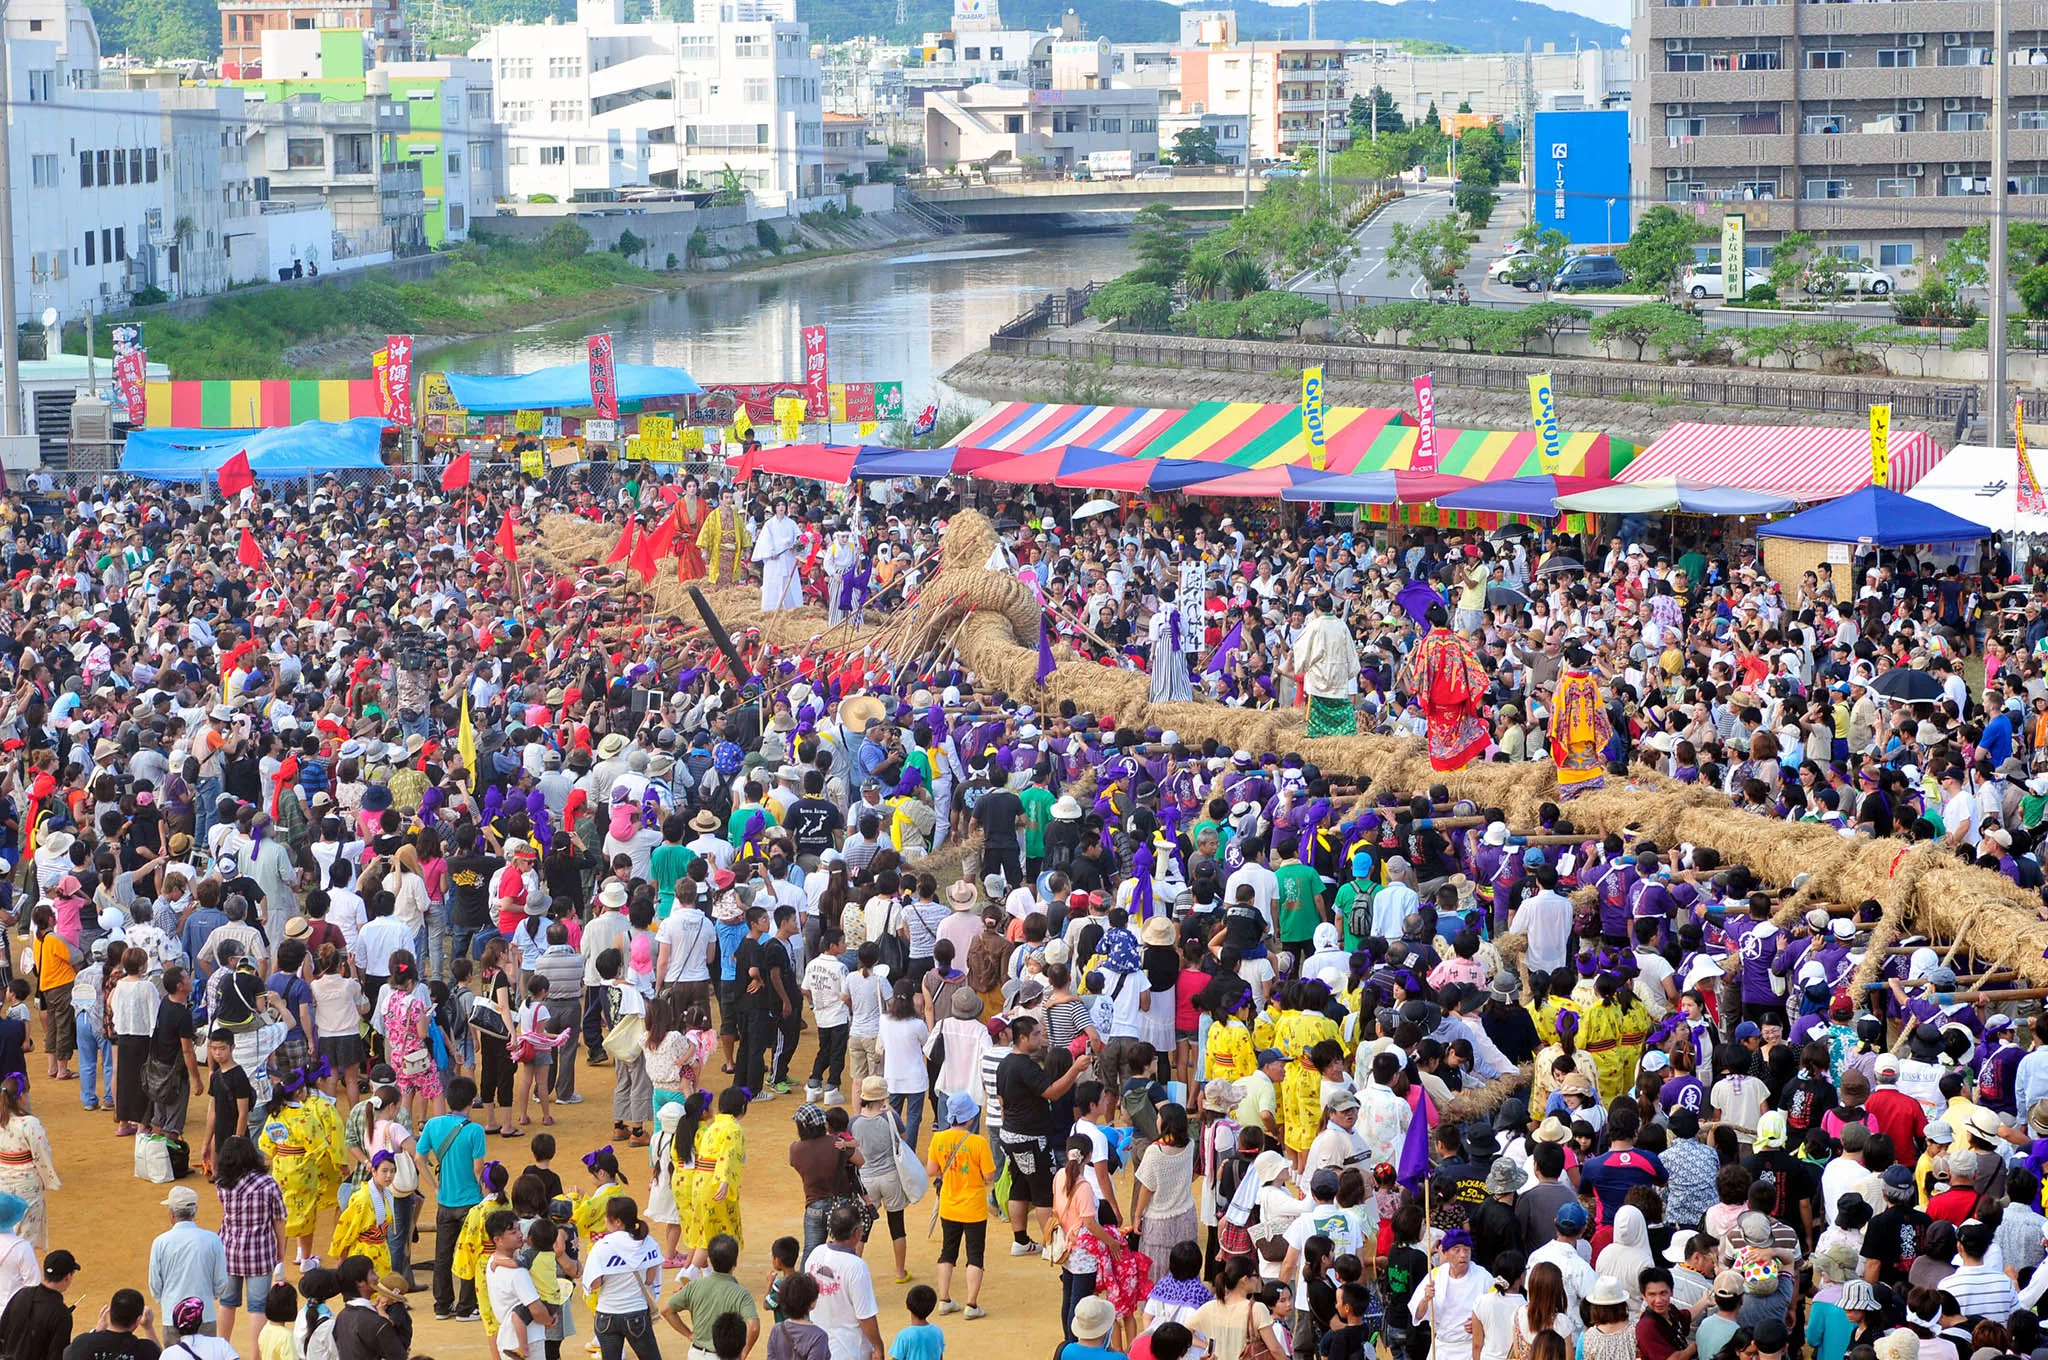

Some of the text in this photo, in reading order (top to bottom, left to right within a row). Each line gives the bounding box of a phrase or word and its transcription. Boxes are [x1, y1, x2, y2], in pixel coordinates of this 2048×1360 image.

[1728, 233, 1738, 293] よなみね眼科
